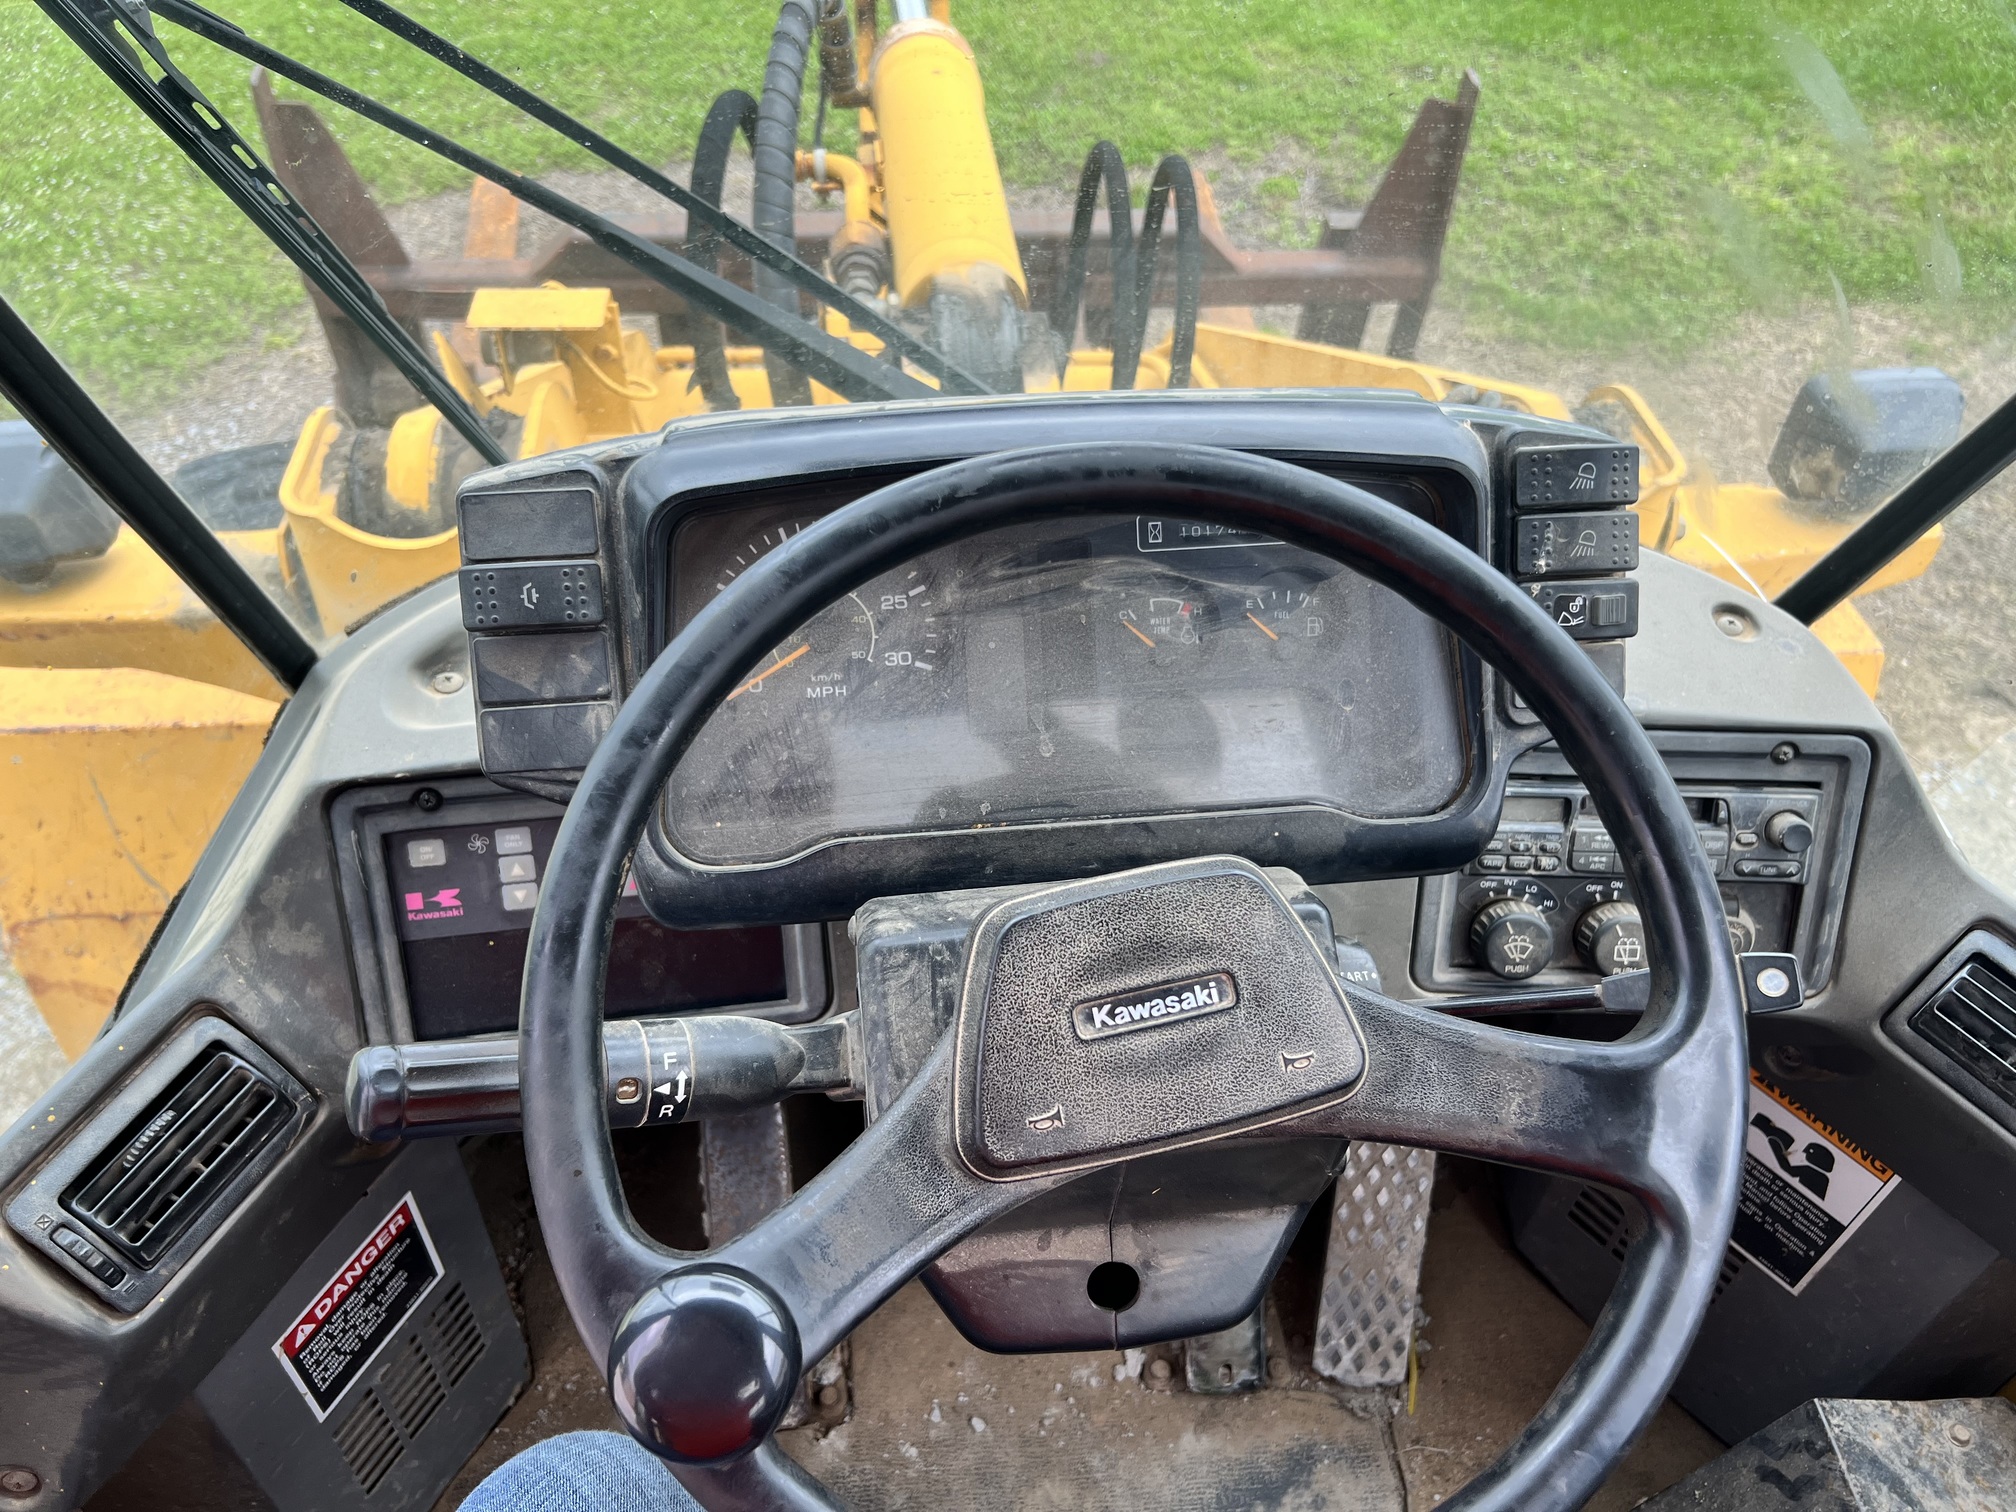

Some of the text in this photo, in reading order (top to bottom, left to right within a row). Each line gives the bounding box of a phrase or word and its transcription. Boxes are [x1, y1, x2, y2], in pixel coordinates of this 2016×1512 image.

[1179, 525, 1249, 538] 10174
[881, 595, 908, 609] 25
[1246, 600, 1254, 609] E
[1119, 611, 1128, 620] C
[1194, 608, 1202, 616] H
[1274, 611, 1290, 619] FUEL
[1150, 617, 1171, 626] WATER
[1153, 626, 1170, 635] TEMP
[851, 651, 866, 659] 50
[885, 652, 912, 666] 30
[811, 673, 841, 681] km/h
[807, 686, 847, 698] MPH
[1582, 835, 1587, 843] 1
[1504, 879, 1518, 887] INT
[1526, 885, 1538, 893] LO
[1610, 881, 1623, 889] ON
[1544, 900, 1553, 908] HI
[408, 907, 464, 921] Kawasaki
[1505, 965, 1530, 973] PUSH
[1091, 982, 1219, 1028] Kawasaki
[663, 1052, 677, 1070] F
[658, 1104, 674, 1118] R
[1750, 1167, 1771, 1185] death
[1770, 1183, 1779, 1192] or
[1778, 1189, 1805, 1212] serious
[1773, 1178, 1784, 1187] or
[1784, 1186, 1829, 1223] maintenance
[1744, 1181, 1824, 1246] Manual before operating
[1758, 1184, 1774, 1197] and
[1771, 1194, 1794, 1214] follow
[1792, 1210, 1828, 1240] Operation
[1743, 1199, 1764, 1216] signs
[1763, 1214, 1773, 1223] in
[1773, 1221, 1808, 1251] Operation
[1752, 1214, 1762, 1223] or
[1763, 1222, 1774, 1232] on
[1773, 1231, 1806, 1258] machine.
[313, 1210, 405, 1321] DANGER
[327, 1312, 345, 1334] Over
[346, 1272, 379, 1312] Protective
[330, 1289, 358, 1323] damage
[311, 1348, 335, 1379] Always
